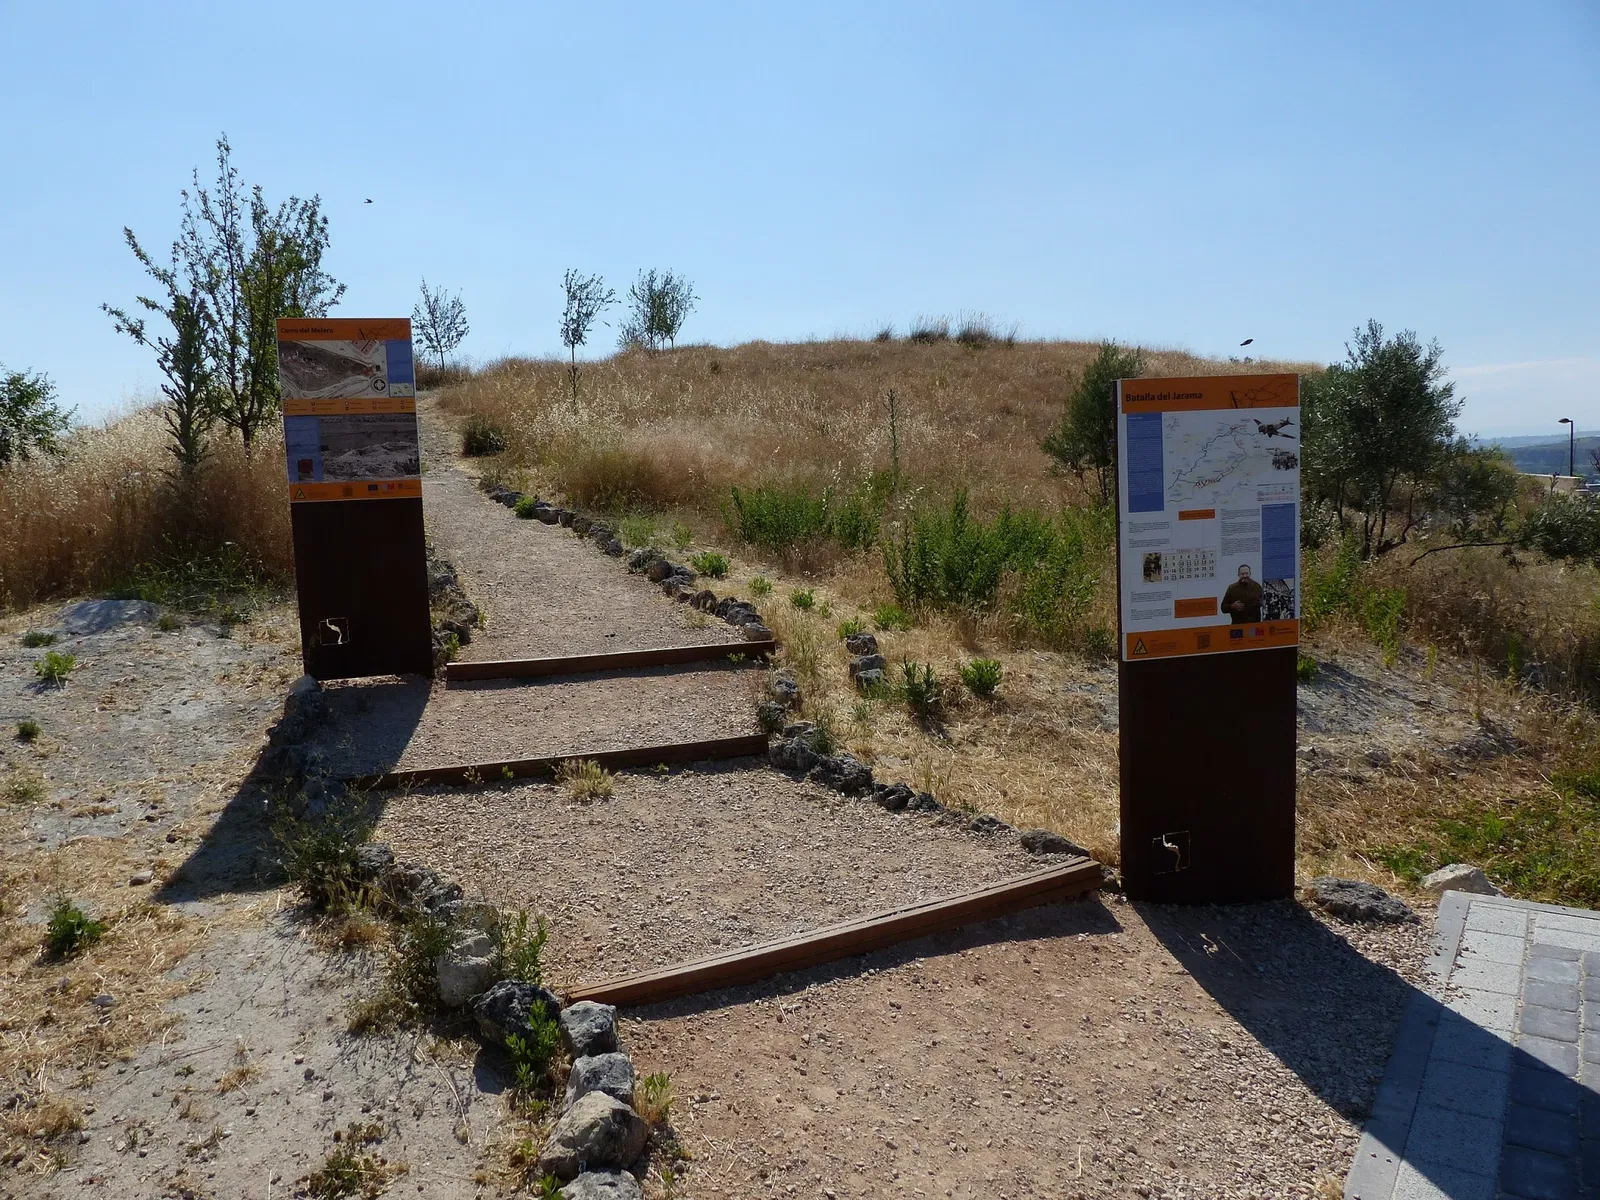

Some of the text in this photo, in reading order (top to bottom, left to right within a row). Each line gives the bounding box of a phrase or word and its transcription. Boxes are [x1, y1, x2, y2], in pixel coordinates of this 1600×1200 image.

[1126, 392, 1203, 402] Batalla del Jarama
